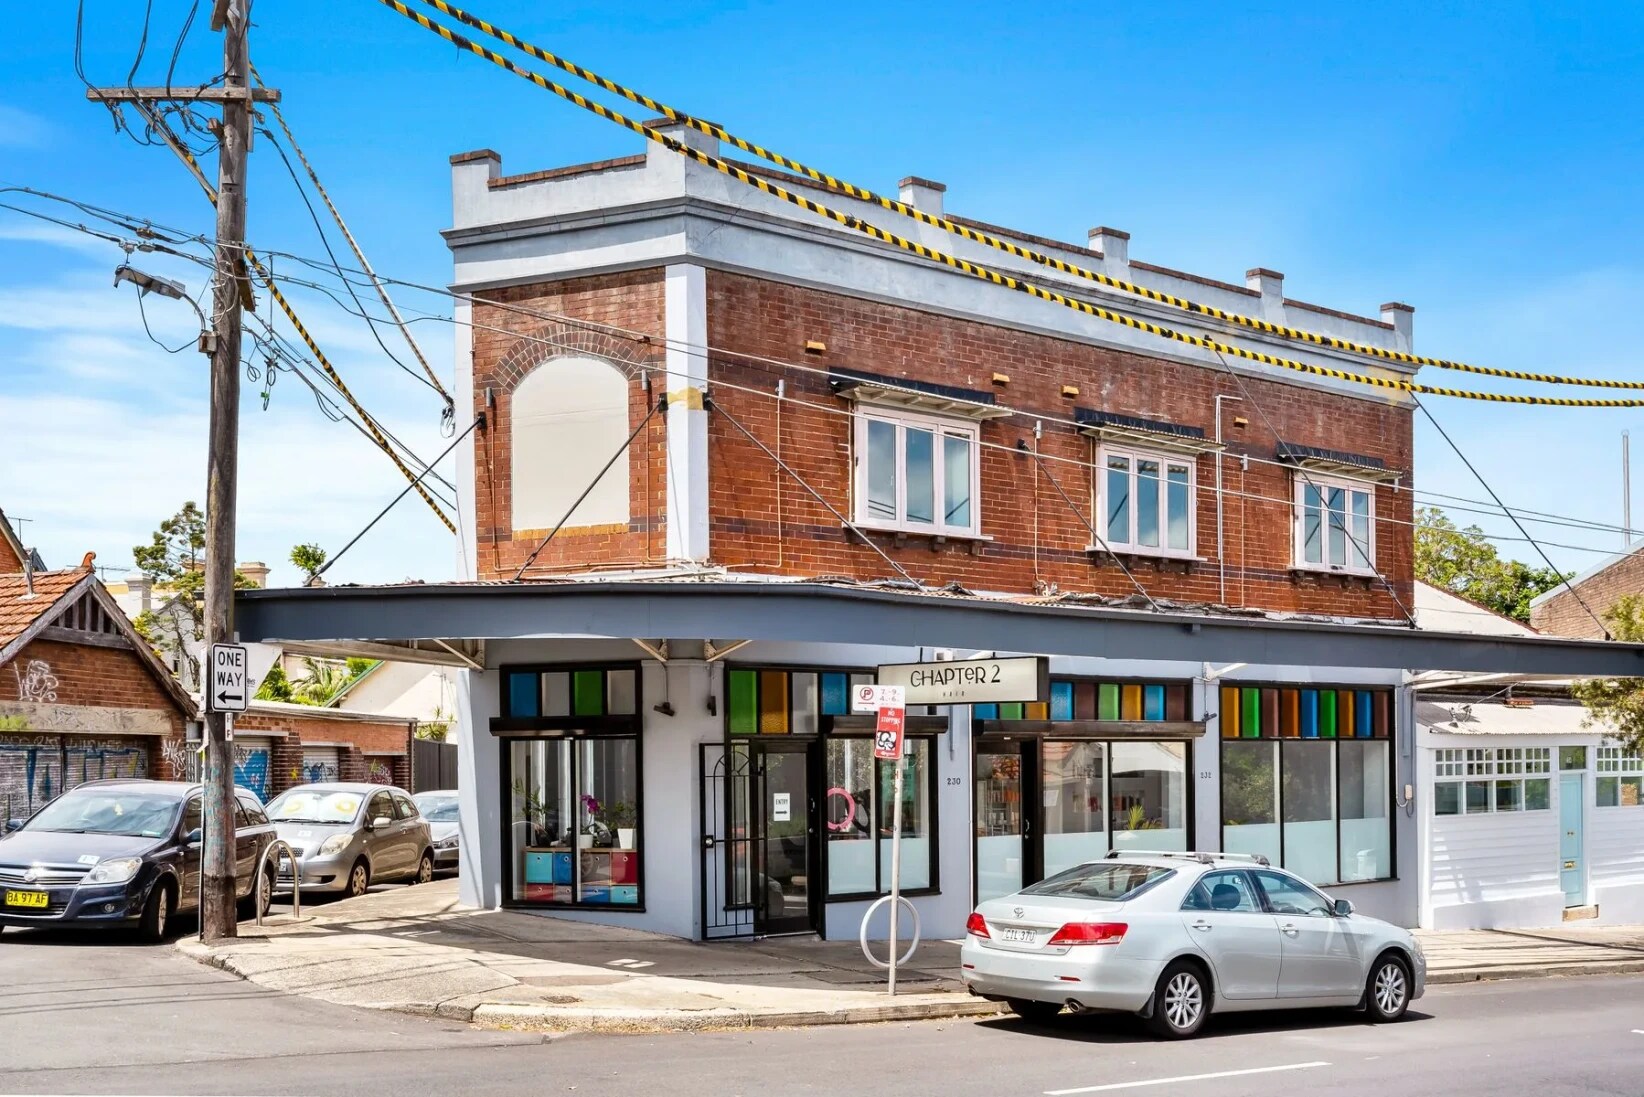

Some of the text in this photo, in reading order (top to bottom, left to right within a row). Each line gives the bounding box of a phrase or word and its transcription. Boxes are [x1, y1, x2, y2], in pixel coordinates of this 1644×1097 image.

[218, 651, 242, 667] ONE
[217, 671, 242, 687] WAY
[990, 664, 1000, 683] 2
[946, 777, 961, 785] 230
[21, 893, 33, 904] 97
[35, 894, 47, 904] AF
